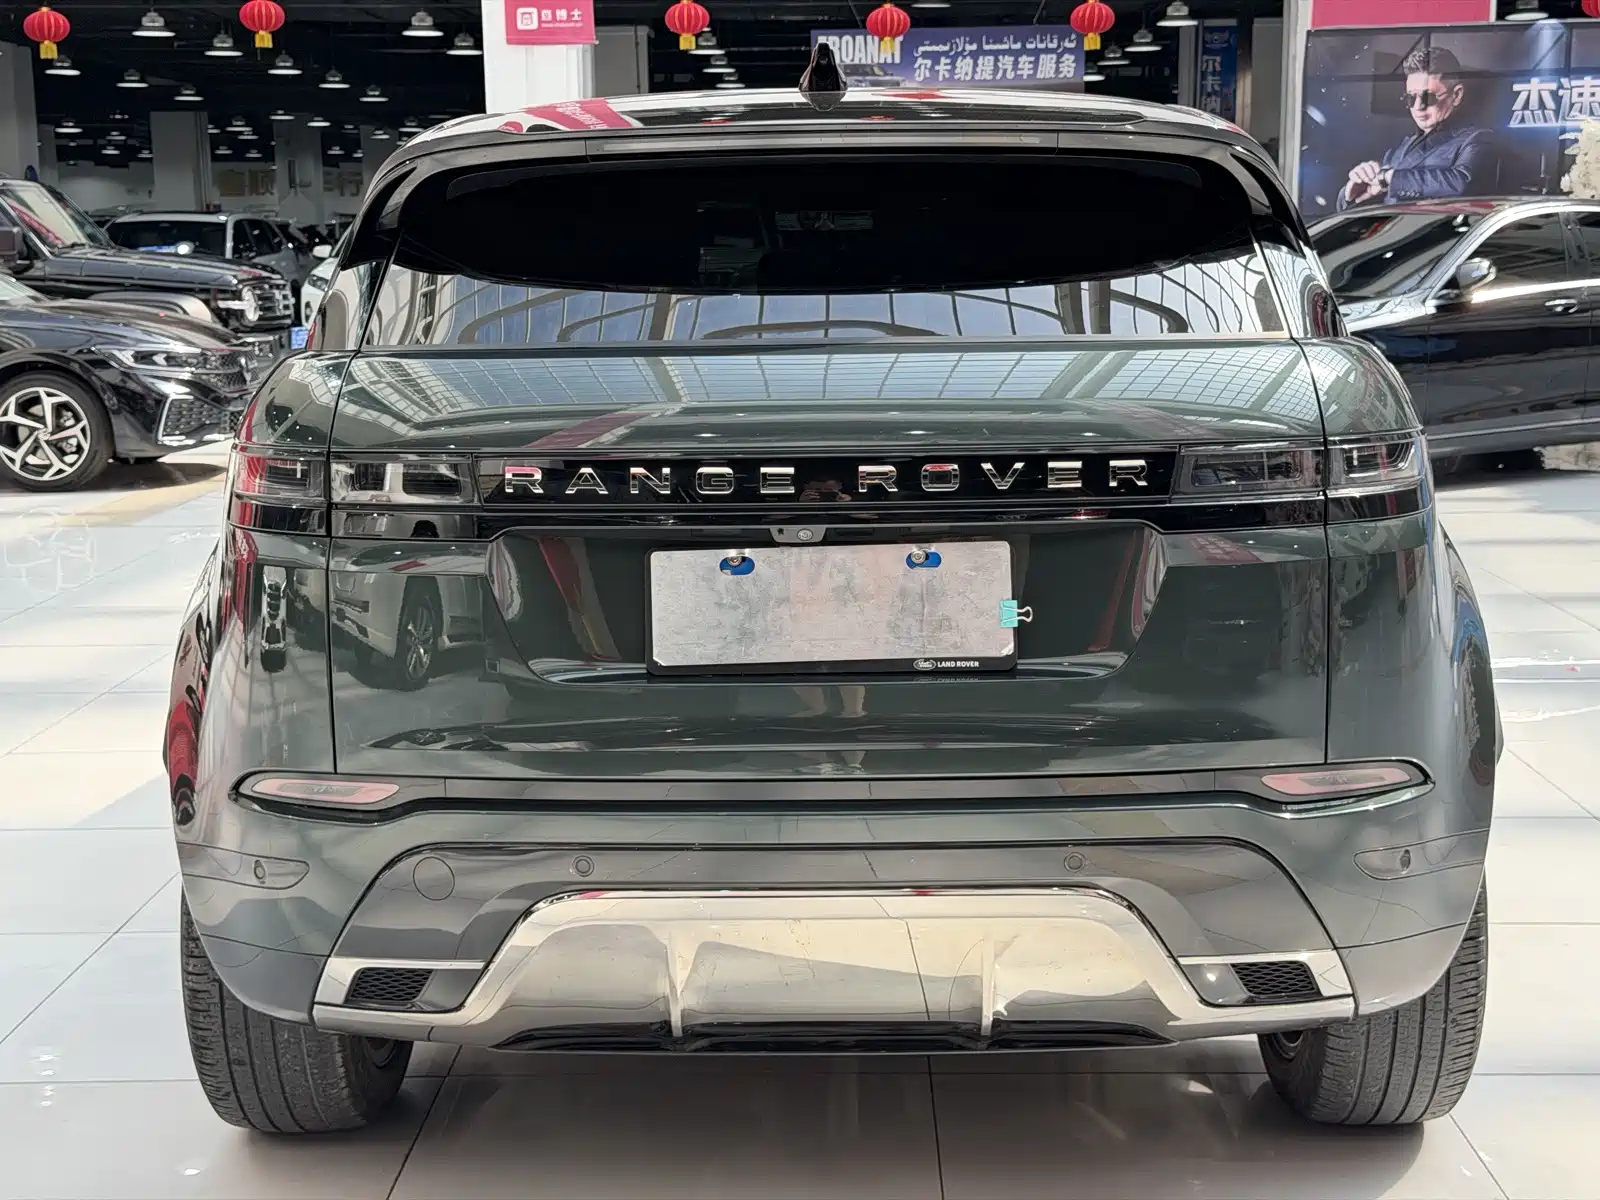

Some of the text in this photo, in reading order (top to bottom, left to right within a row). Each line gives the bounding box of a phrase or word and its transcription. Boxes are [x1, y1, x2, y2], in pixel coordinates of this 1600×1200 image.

[913, 53, 1077, 82] 尔卡纳提汽车服务
[504, 459, 1148, 494] RANGE ROVER
